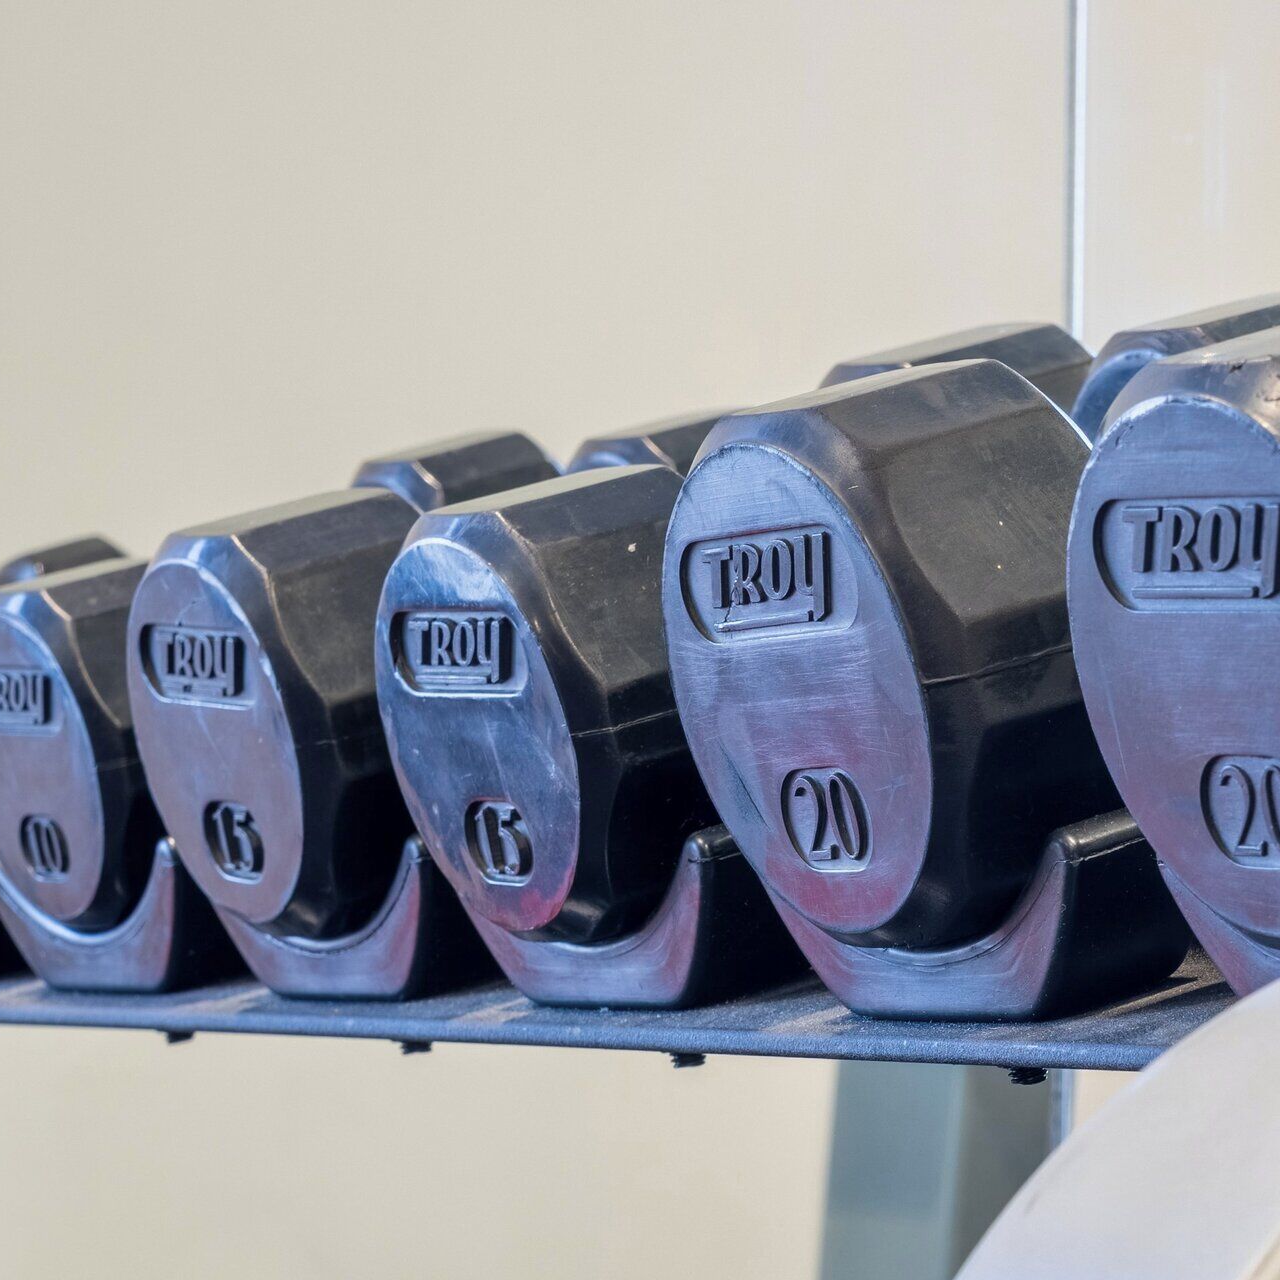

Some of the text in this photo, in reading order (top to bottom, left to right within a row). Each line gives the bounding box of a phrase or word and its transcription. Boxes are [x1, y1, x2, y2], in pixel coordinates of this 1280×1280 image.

[701, 530, 830, 623] TROY
[157, 626, 240, 697] TROY
[409, 616, 504, 684] TROY
[25, 817, 67, 876] 10
[211, 803, 262, 873] 15
[474, 803, 531, 875] 15
[793, 769, 867, 863] 20
